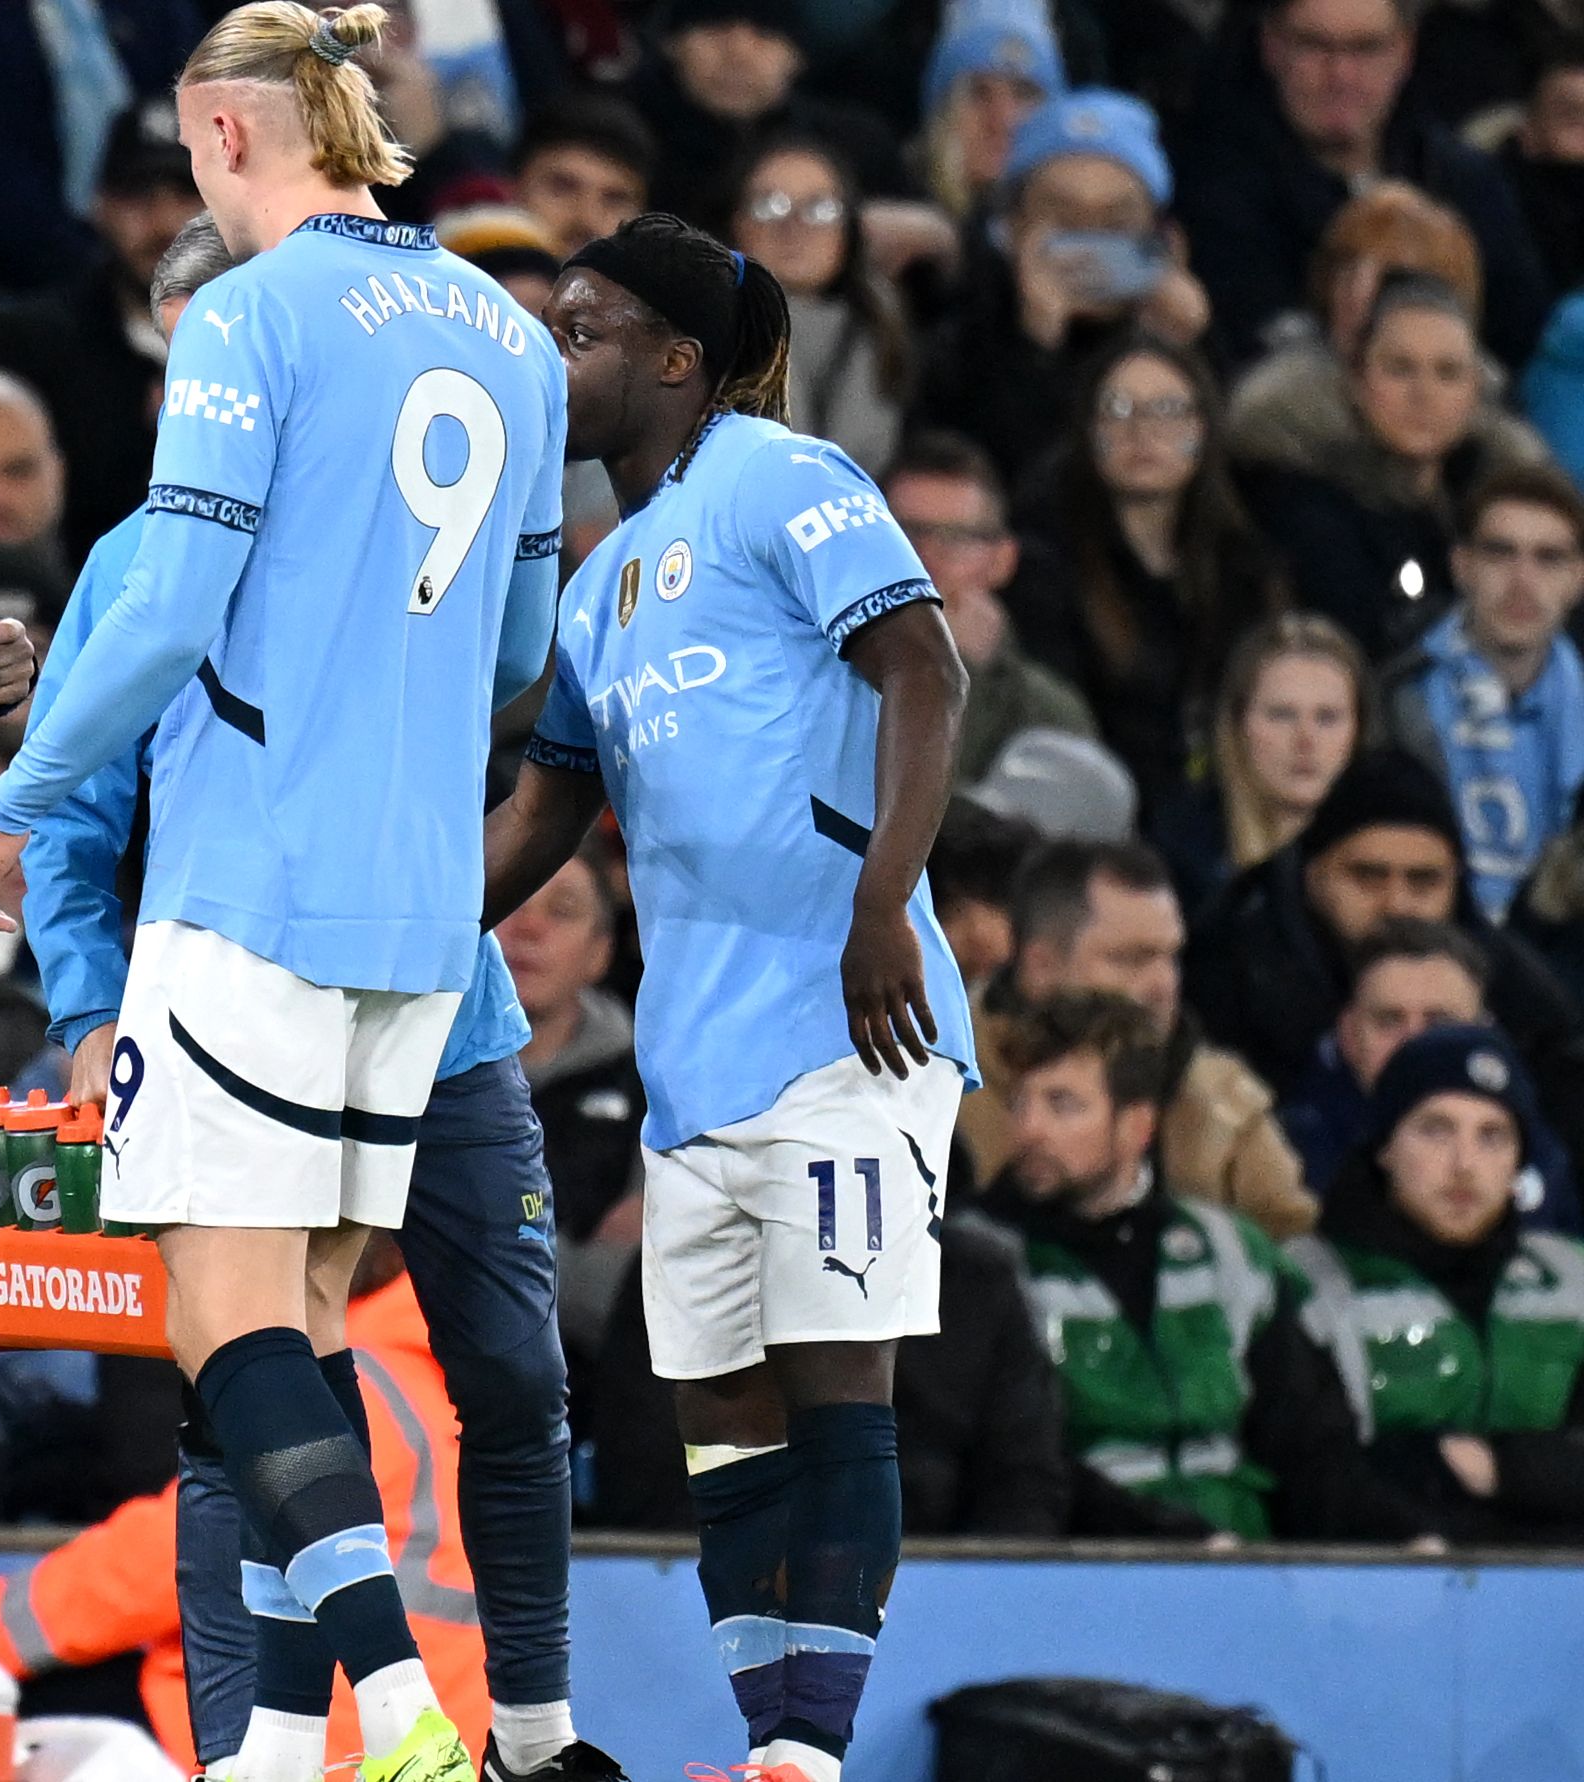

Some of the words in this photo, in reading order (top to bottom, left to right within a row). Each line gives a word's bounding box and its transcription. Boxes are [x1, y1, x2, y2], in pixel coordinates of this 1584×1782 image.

[339, 272, 526, 357] HAALAND
[167, 379, 260, 432] OKX
[390, 366, 507, 616] 9
[110, 1036, 144, 1132] 9
[18, 1166, 62, 1222] G
[521, 1191, 544, 1220] DH
[808, 1158, 882, 1251] 11
